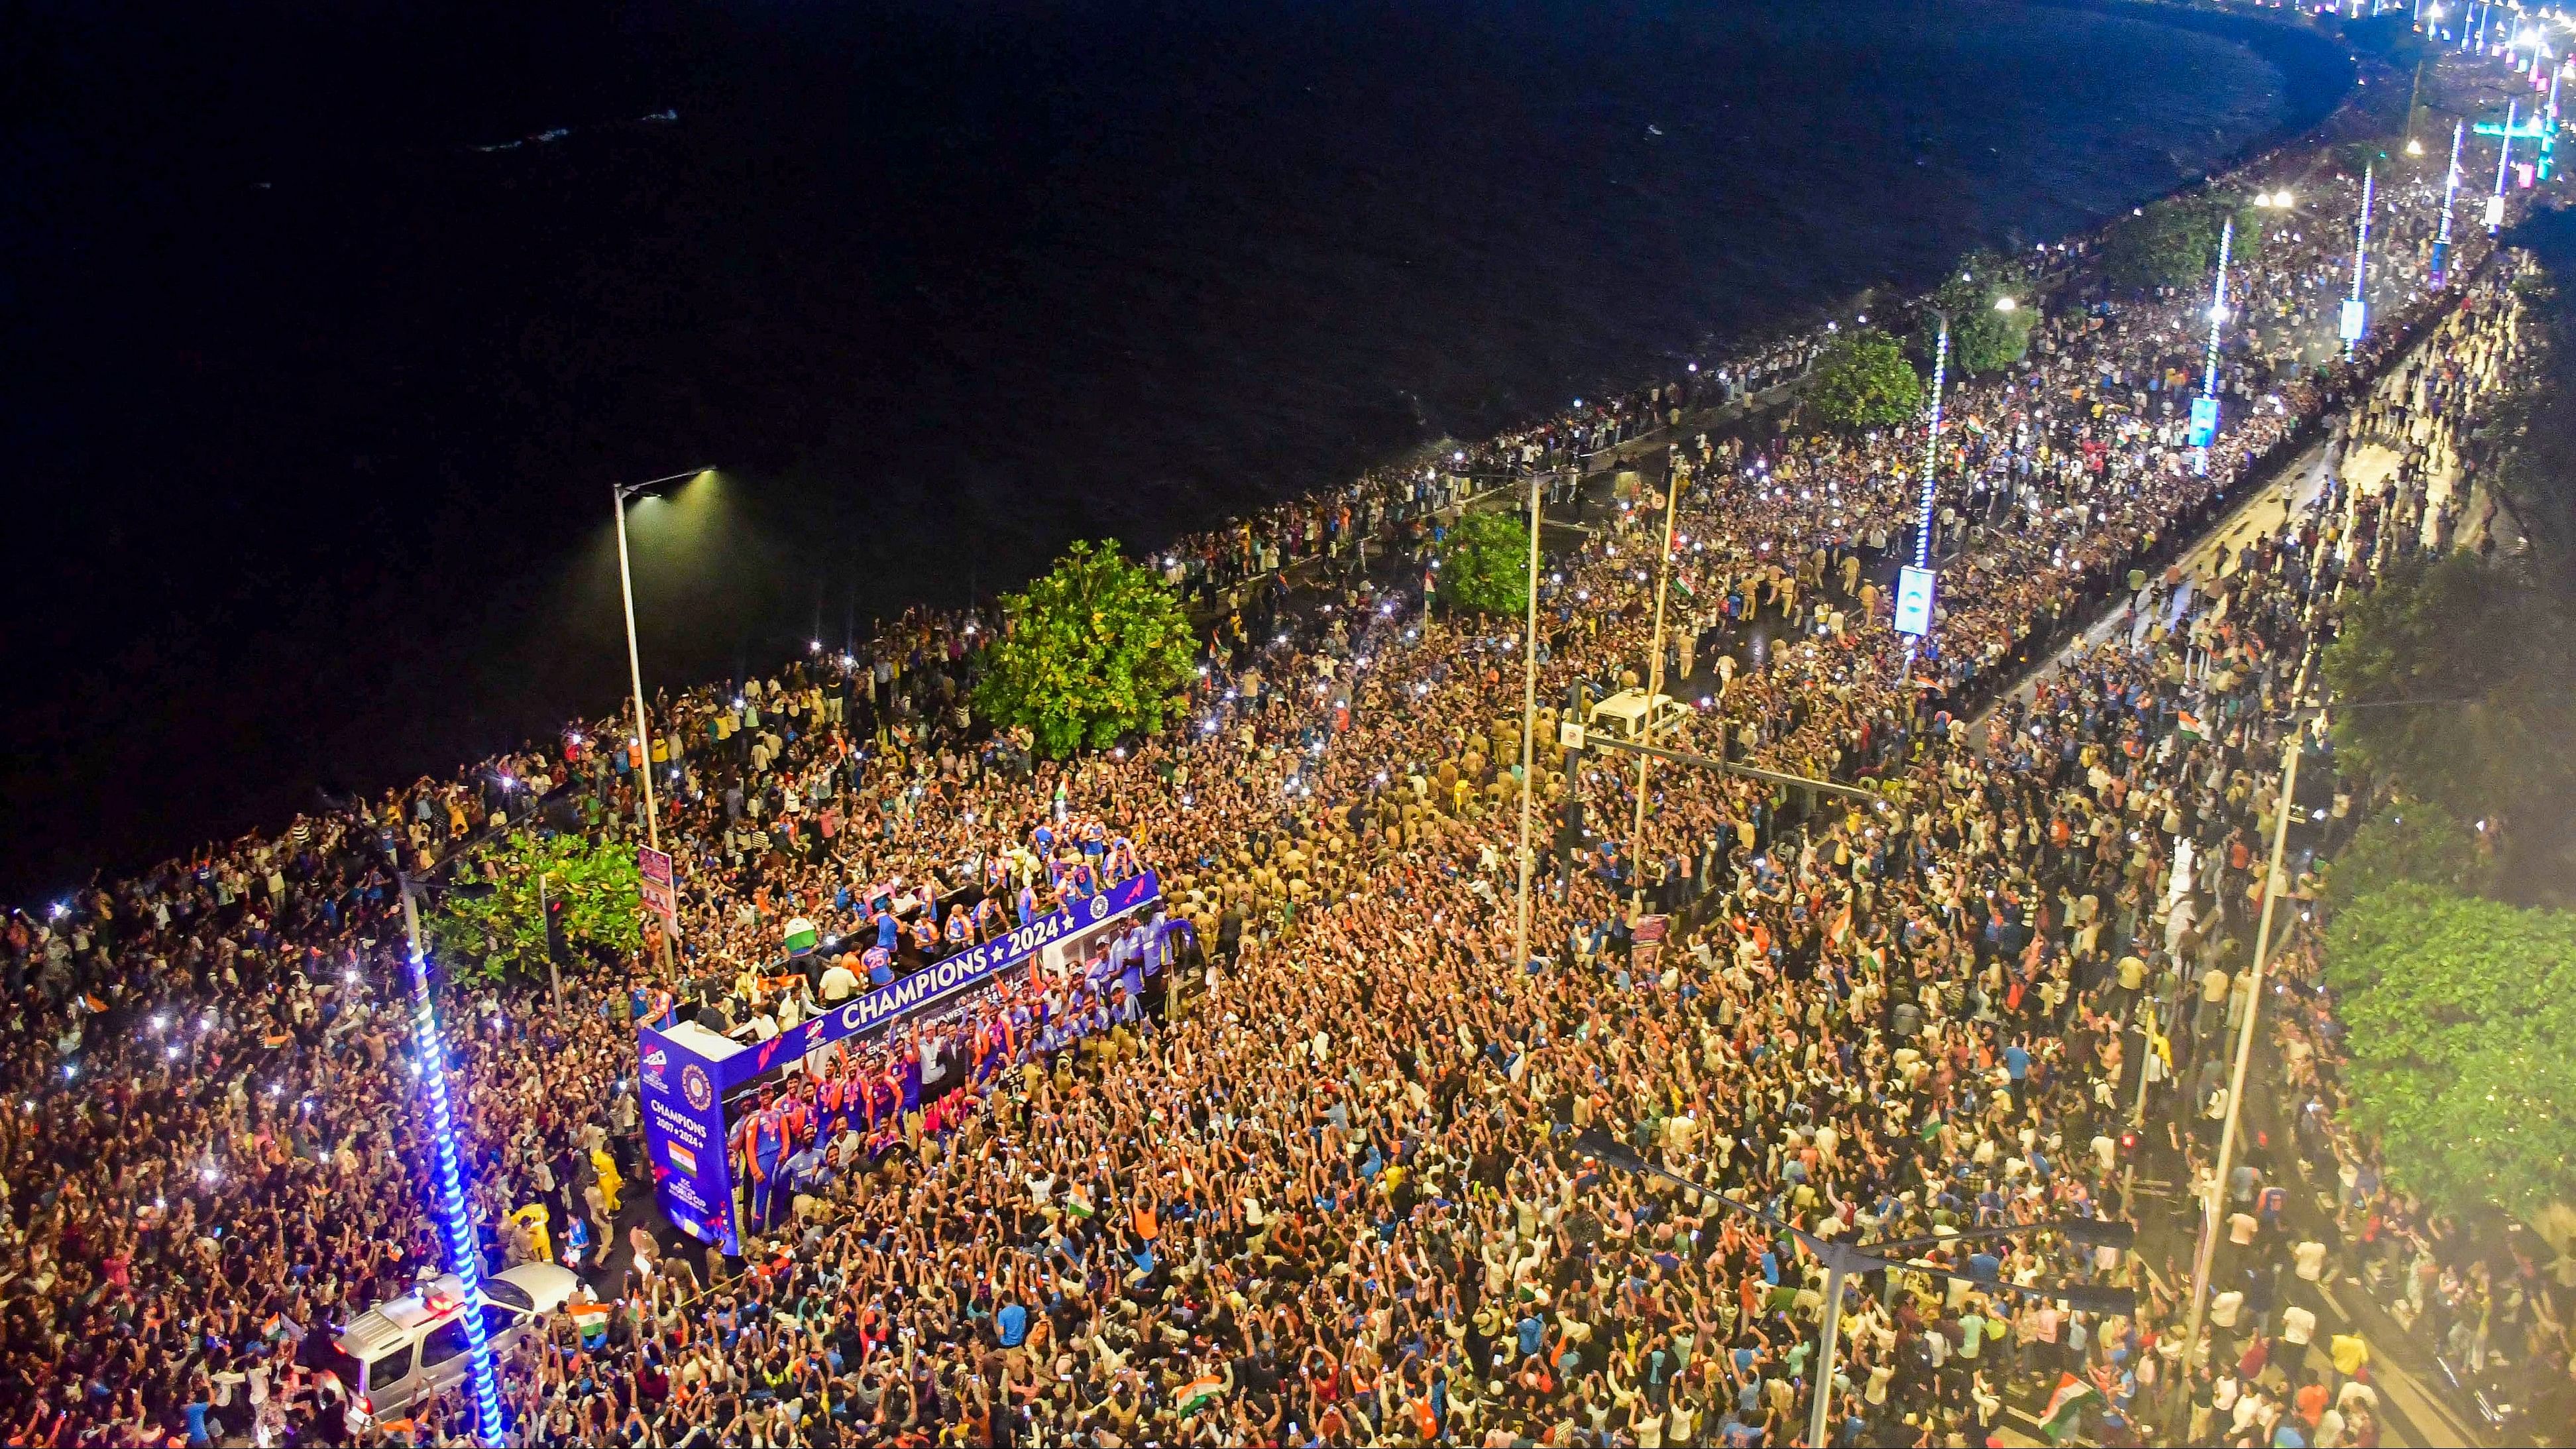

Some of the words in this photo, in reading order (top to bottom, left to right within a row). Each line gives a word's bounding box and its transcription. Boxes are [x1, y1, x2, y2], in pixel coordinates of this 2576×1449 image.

[842, 949, 987, 1029] CHAMPIONS
[1007, 916, 1059, 958] 2024
[869, 955, 885, 969] 25
[651, 1099, 707, 1138] CHAMPIONS
[656, 1116, 674, 1133] 2007
[679, 1130, 698, 1147] 2024
